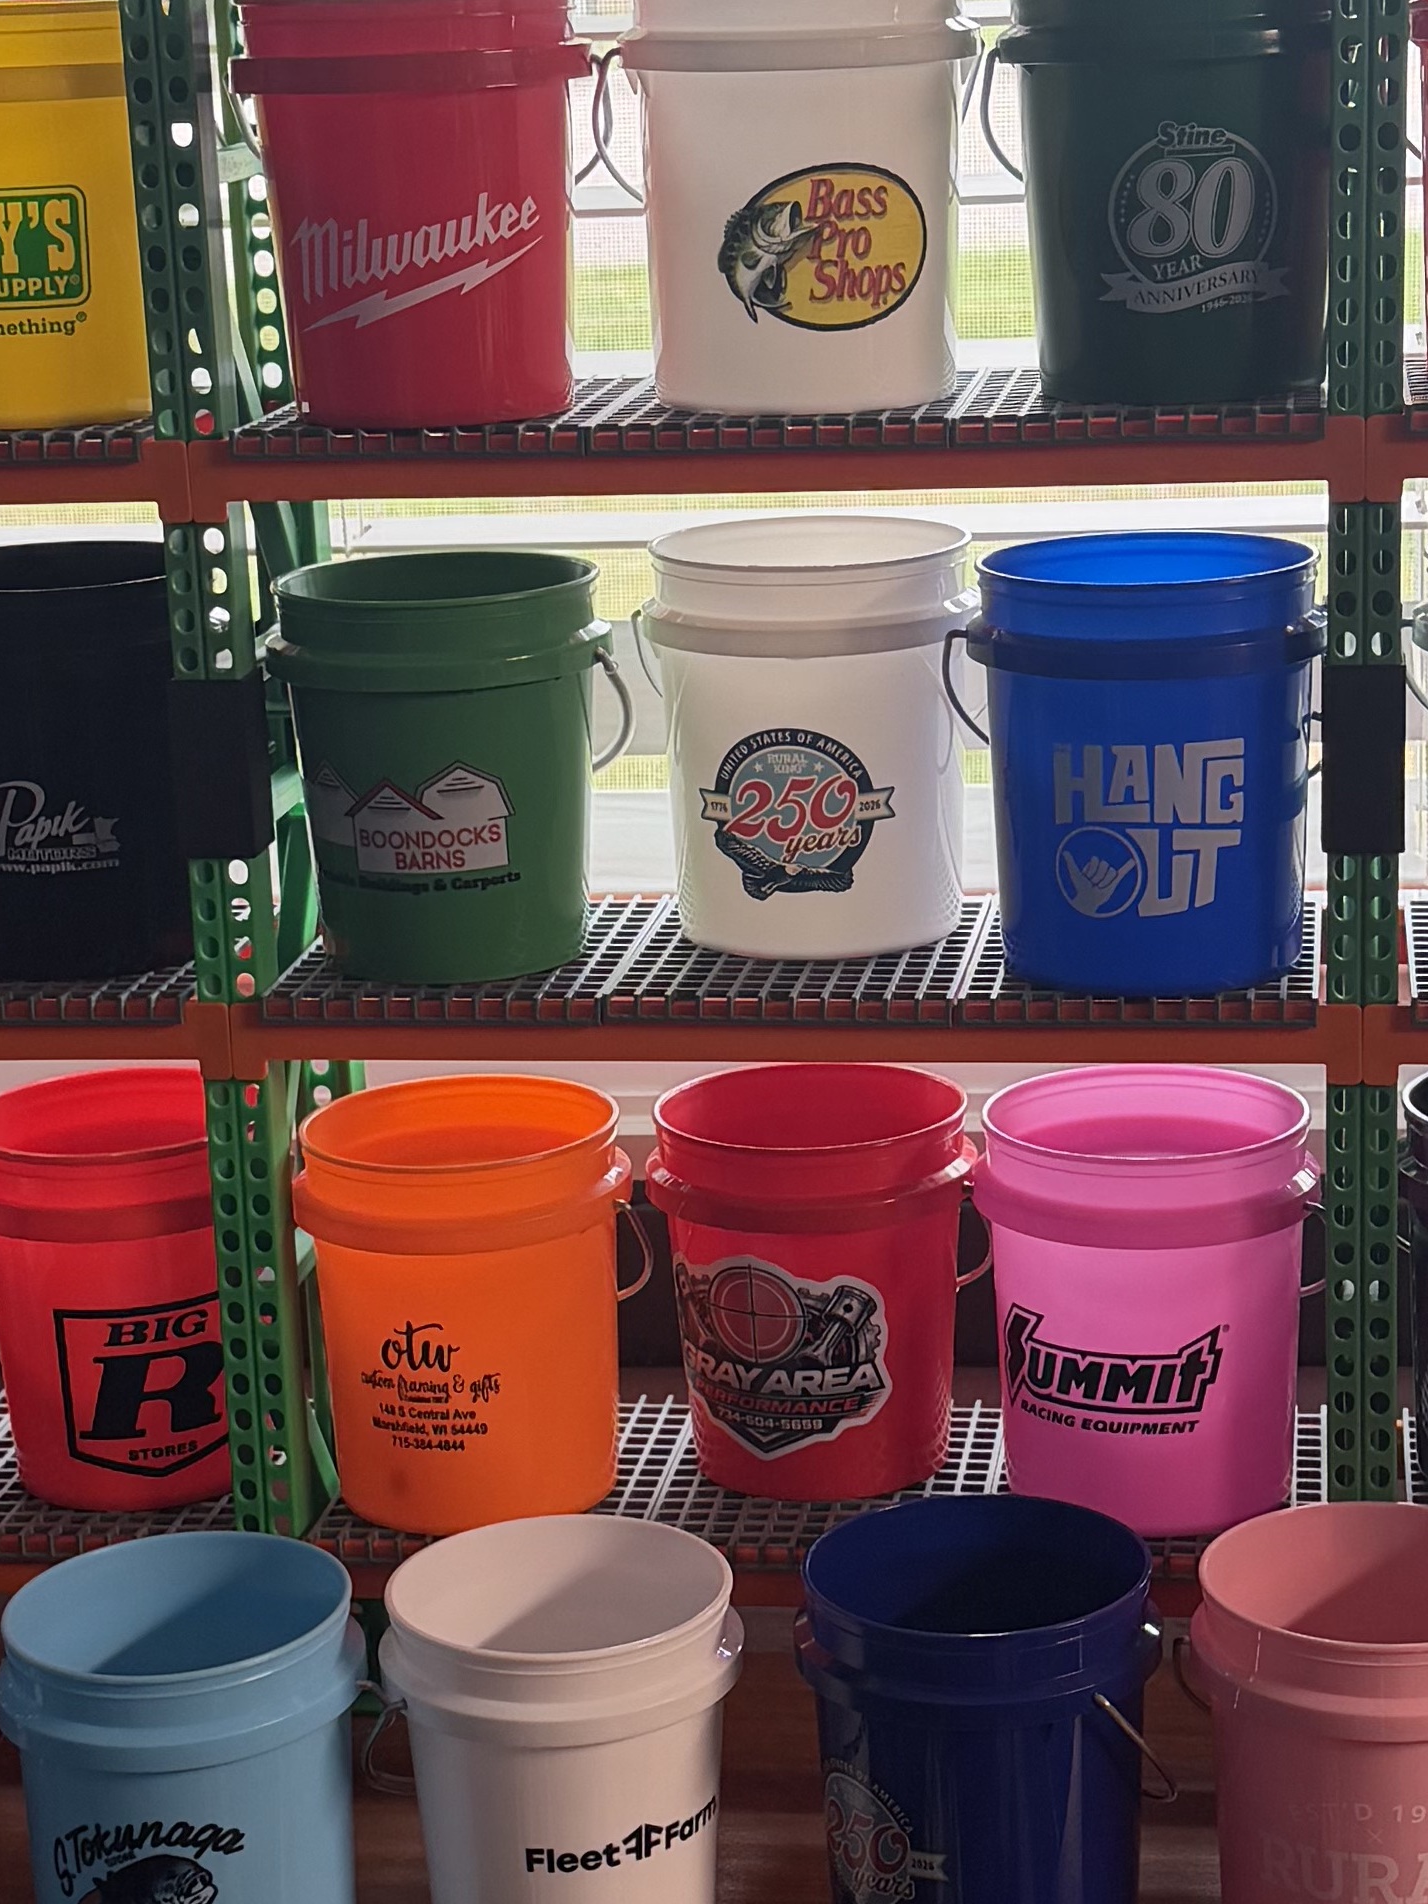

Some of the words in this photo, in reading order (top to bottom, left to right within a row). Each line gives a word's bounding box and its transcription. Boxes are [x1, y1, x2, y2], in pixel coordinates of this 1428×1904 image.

[1157, 121, 1228, 151] Stine
[804, 178, 889, 223] Bass
[1132, 156, 1255, 258] 80
[292, 192, 541, 304] Milwaukee
[809, 221, 873, 261] Pro
[808, 258, 907, 308] Shops
[1151, 254, 1204, 281] YEAR
[1133, 268, 1260, 306] ANNIVERSARY
[719, 745, 749, 781] UNITED
[750, 731, 791, 749] STATES
[797, 733, 814, 744] OF
[815, 738, 864, 780] AMERICA
[1053, 736, 1245, 827] HANG
[724, 774, 859, 844] 250
[859, 799, 881, 812] 2026
[358, 824, 503, 850] BOONDOCKS
[782, 825, 862, 864] years
[394, 849, 467, 871] BARNS
[103, 1309, 210, 1347] BIG
[79, 1341, 228, 1442] R
[469, 1372, 502, 1403] gifts
[693, 1378, 861, 1415] PERFORMANCE
[761, 1365, 883, 1396] AREA
[408, 1407, 450, 1421] Central
[452, 1408, 477, 1420] Ave
[1022, 1400, 1076, 1429] RACING
[1080, 1417, 1200, 1437] EQUIPMENT
[127, 1440, 199, 1461] STORES
[63, 1820, 246, 1872] Tokunaga
[525, 1844, 622, 1874] Fleet
